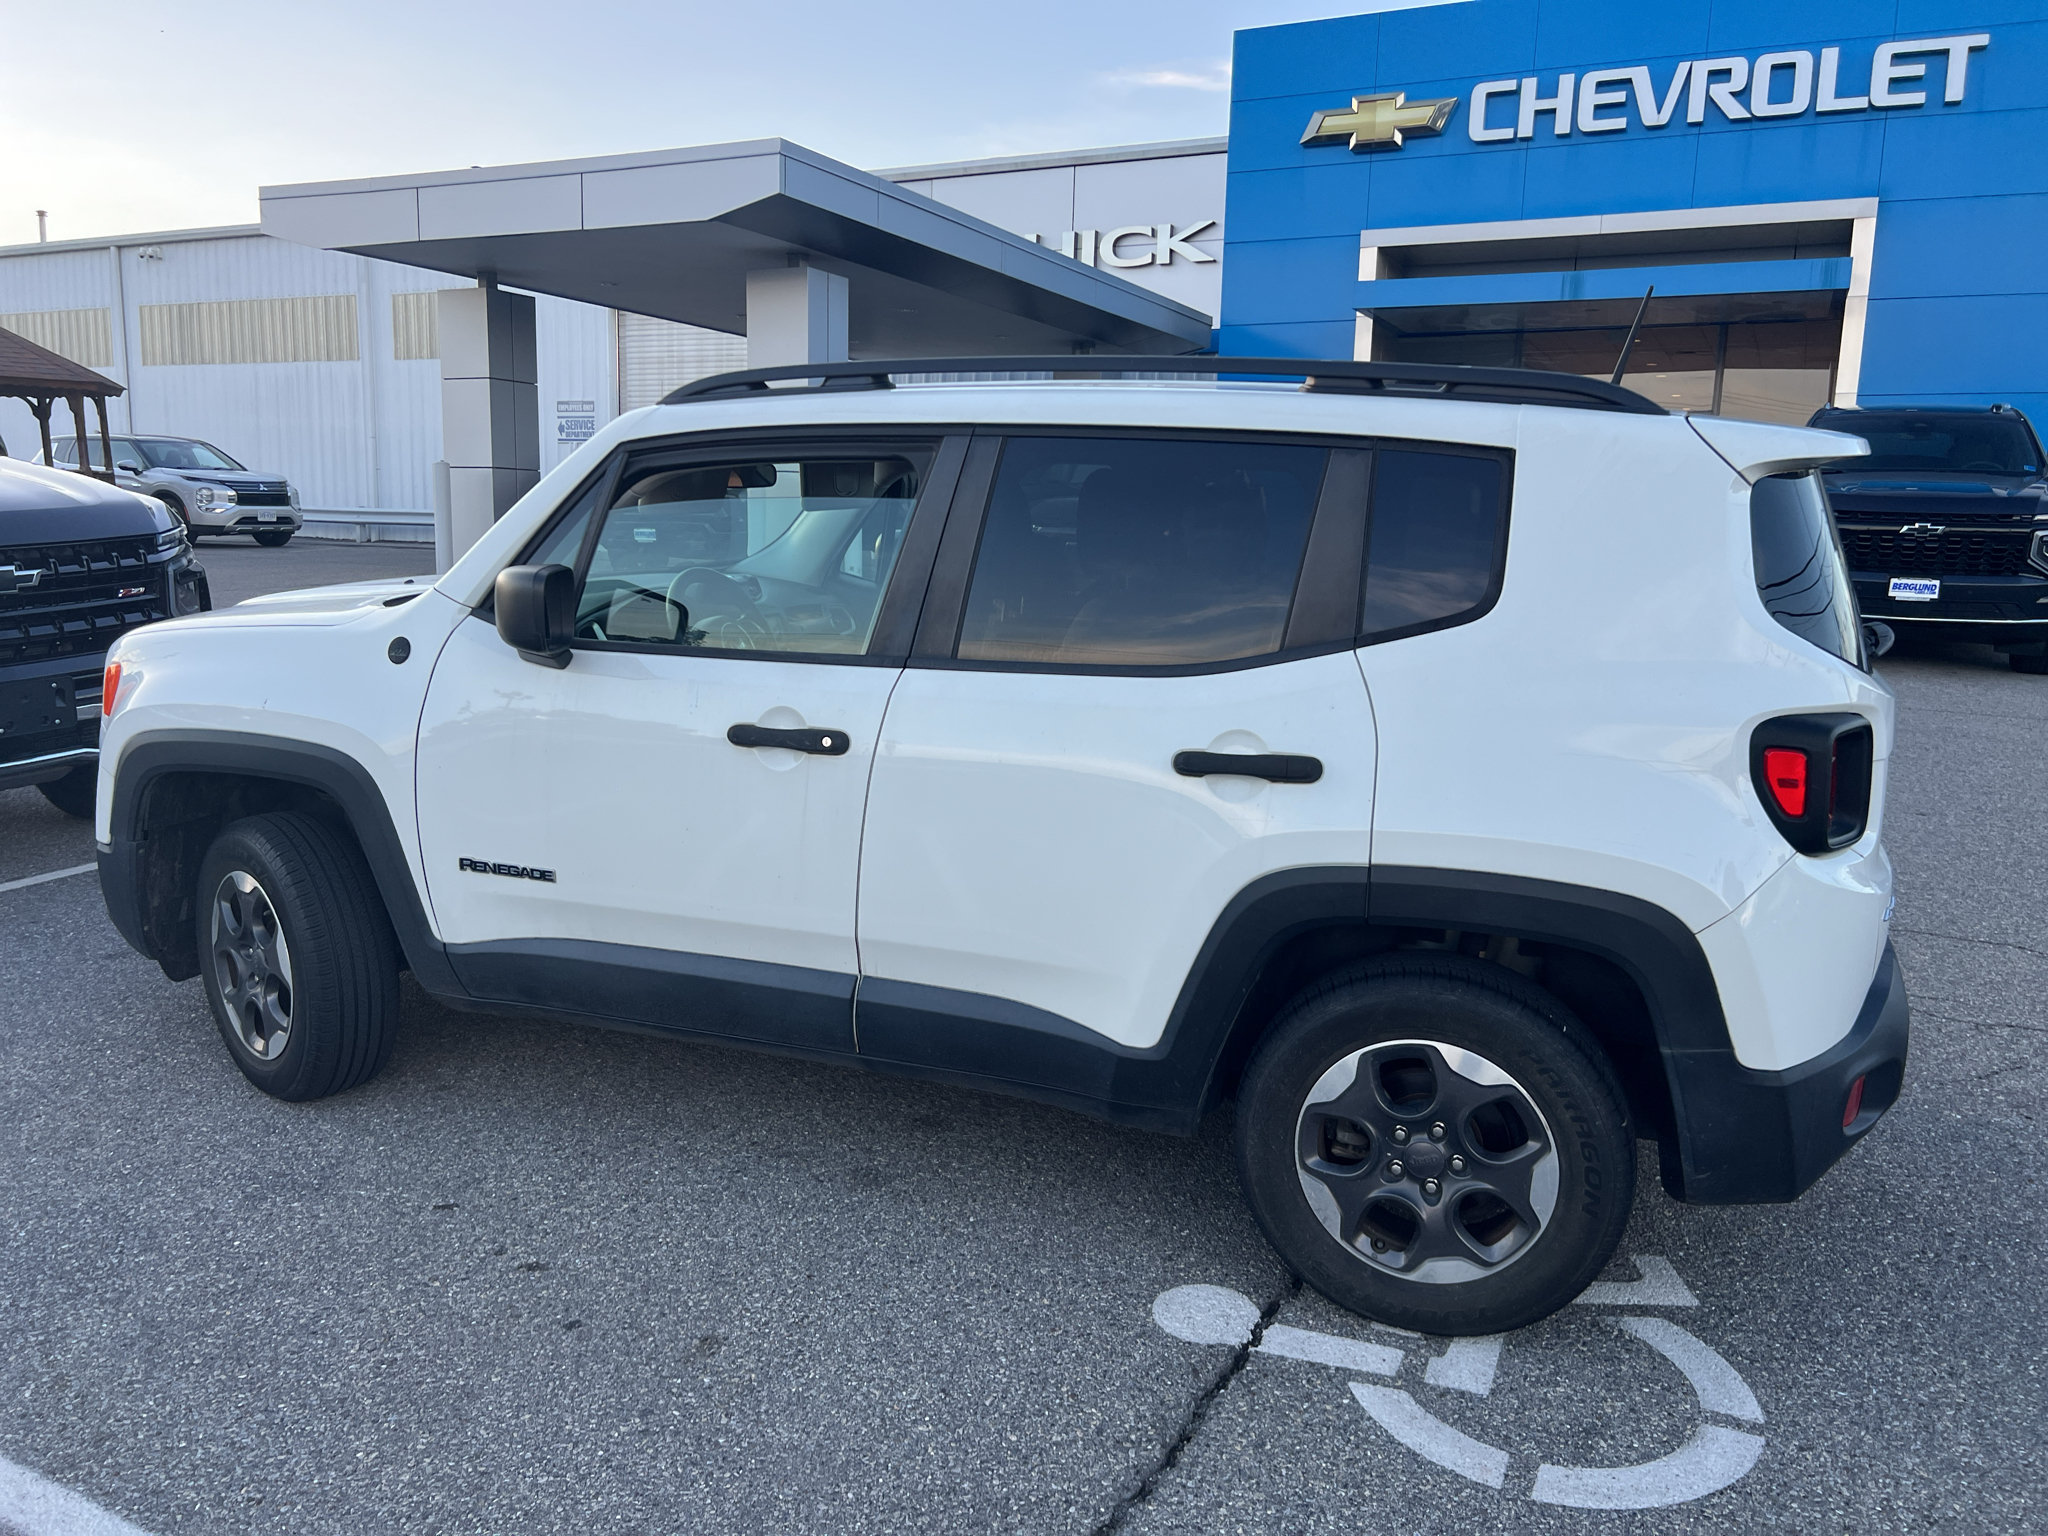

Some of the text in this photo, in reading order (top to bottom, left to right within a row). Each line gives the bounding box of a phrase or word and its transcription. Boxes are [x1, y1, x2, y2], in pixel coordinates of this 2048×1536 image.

[1468, 33, 1990, 143] CHEVROLET
[1025, 221, 1216, 268] ICK
[565, 420, 595, 431] SERVICE
[1892, 583, 1937, 592] BERGLUND
